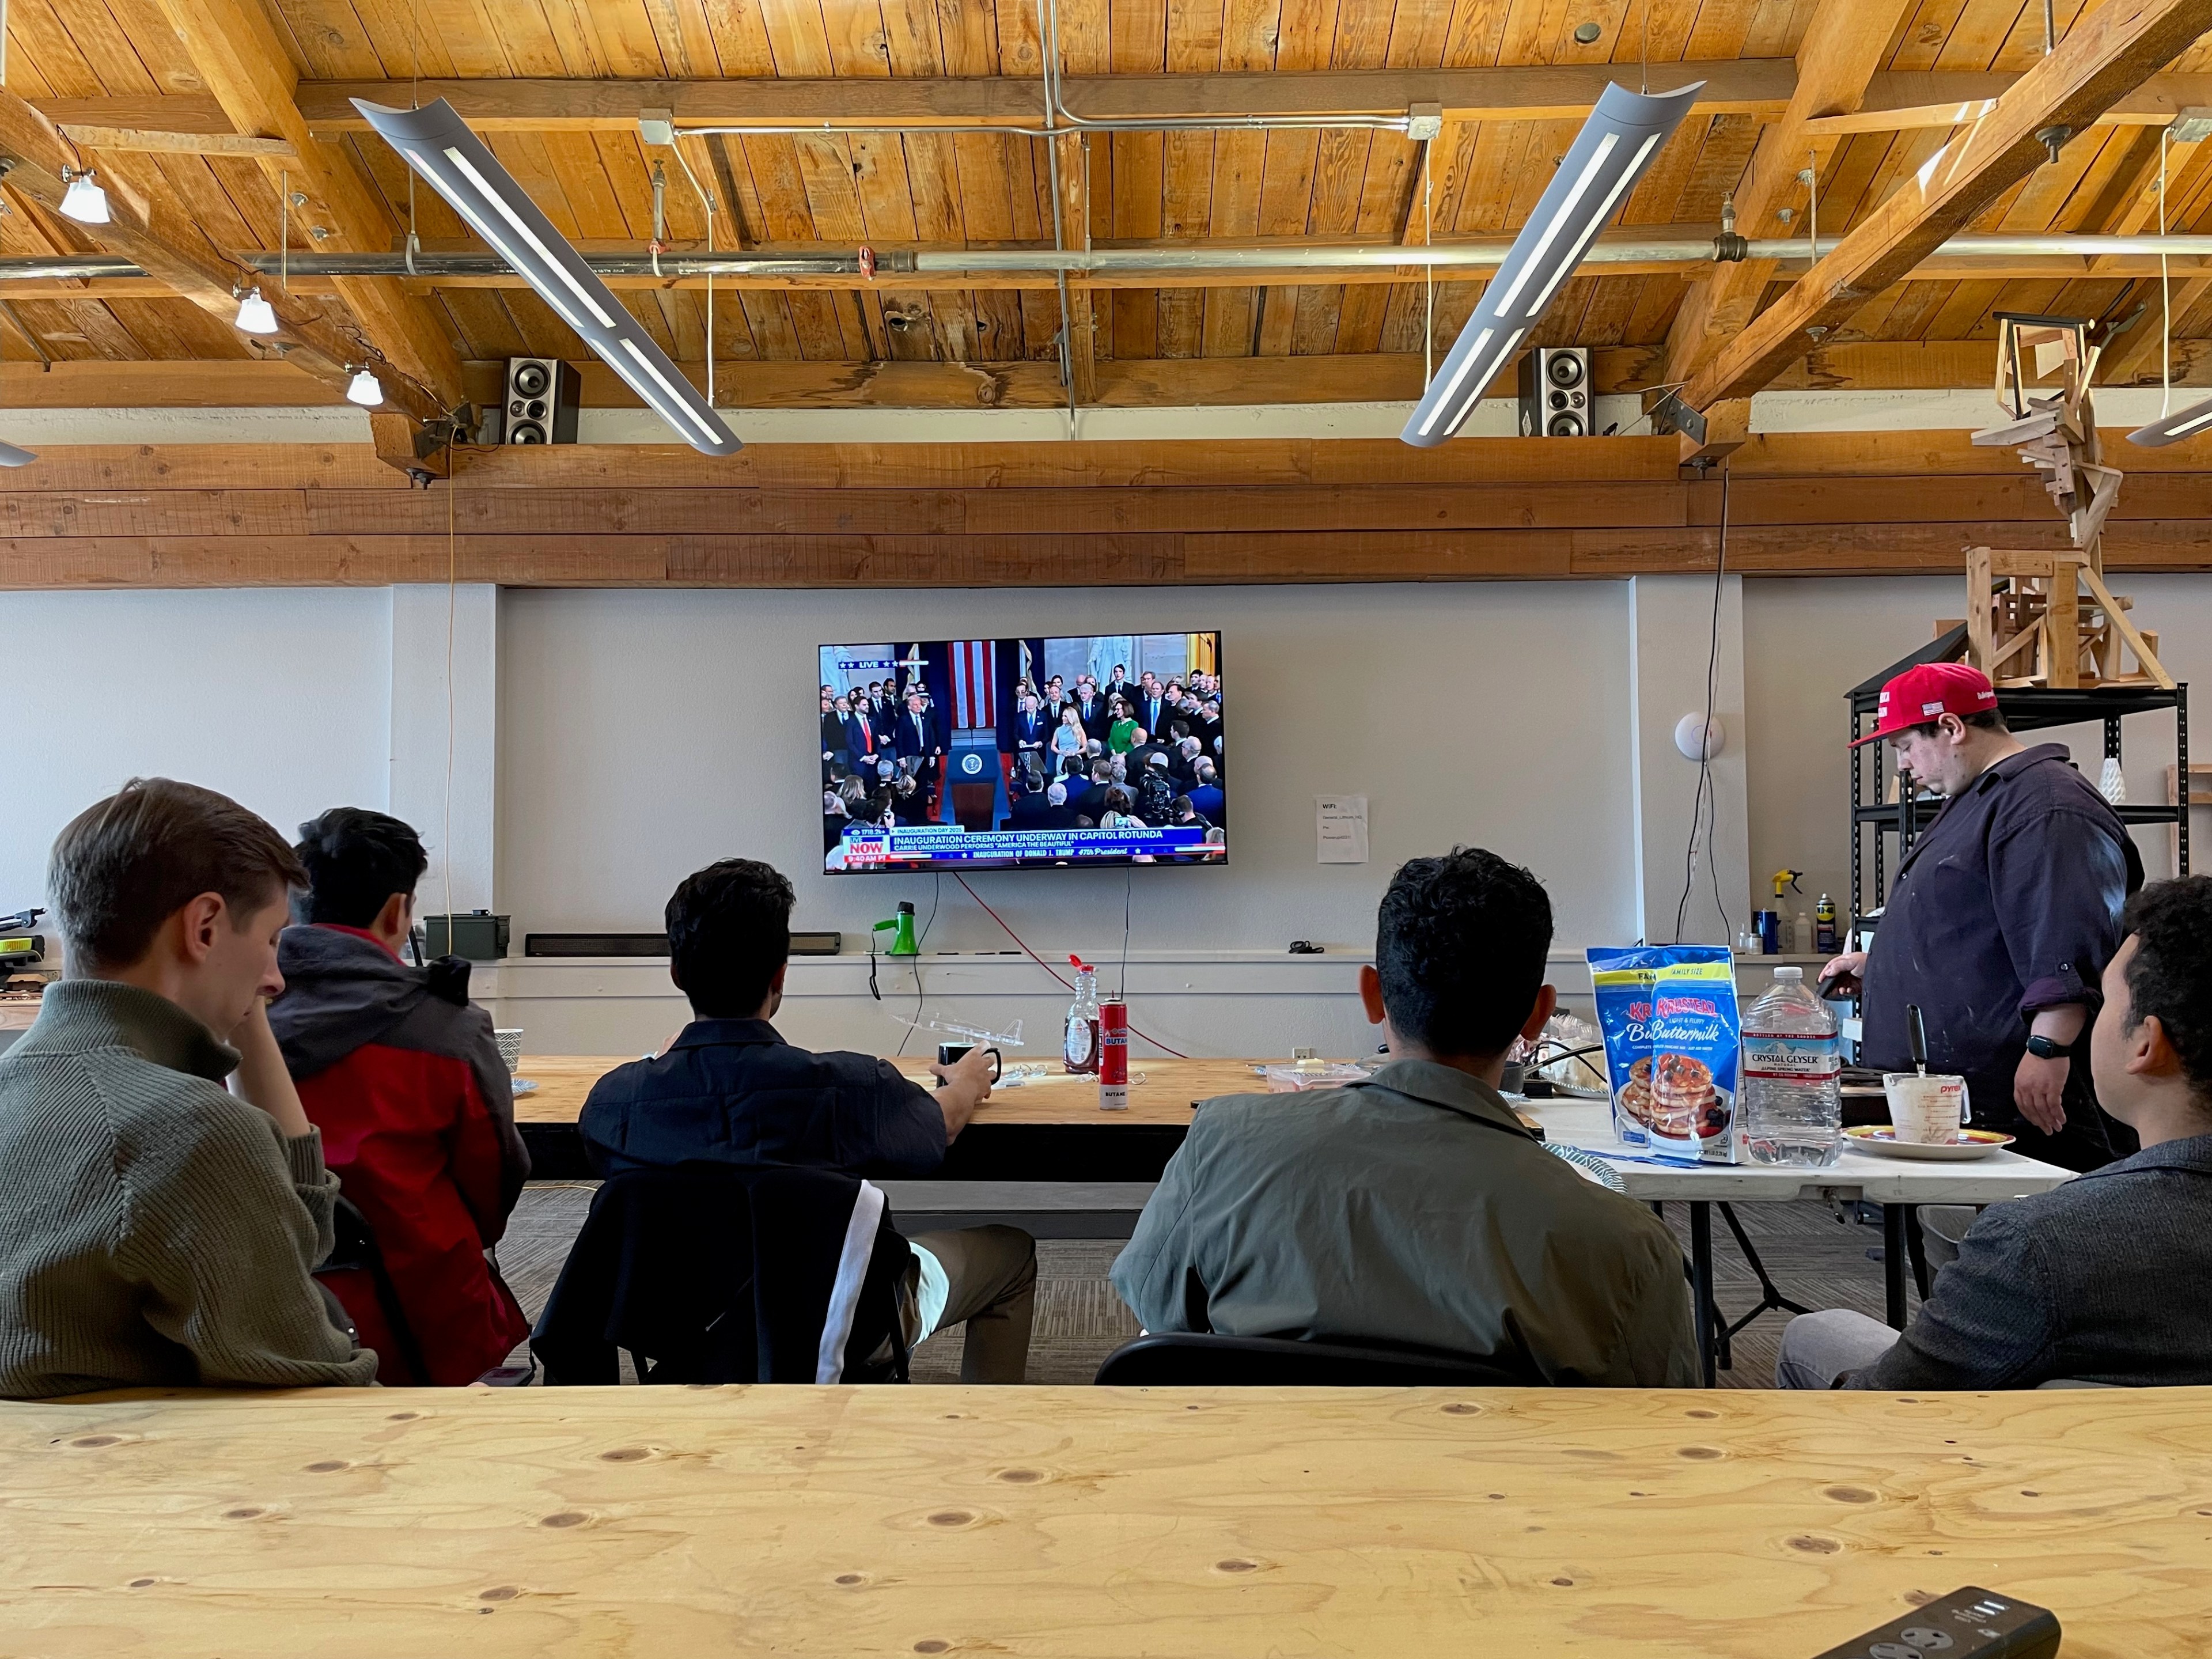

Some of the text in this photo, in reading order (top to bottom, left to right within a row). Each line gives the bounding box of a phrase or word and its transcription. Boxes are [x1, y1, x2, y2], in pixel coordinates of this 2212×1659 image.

[893, 830, 1163, 845] INAUGURATION CEREMONY UNDERWAY IN CAPITOL ROTUNDA
[850, 843, 884, 854] NOW
[973, 850, 1014, 858] INAUGURATION
[1094, 847, 1128, 855] President
[1656, 997, 1718, 1018] KRUSTEAZ
[1652, 1018, 1719, 1042] Buttermilk
[1752, 1054, 1786, 1063] CRYSTAL
[1786, 1055, 1819, 1064] GEYSER
